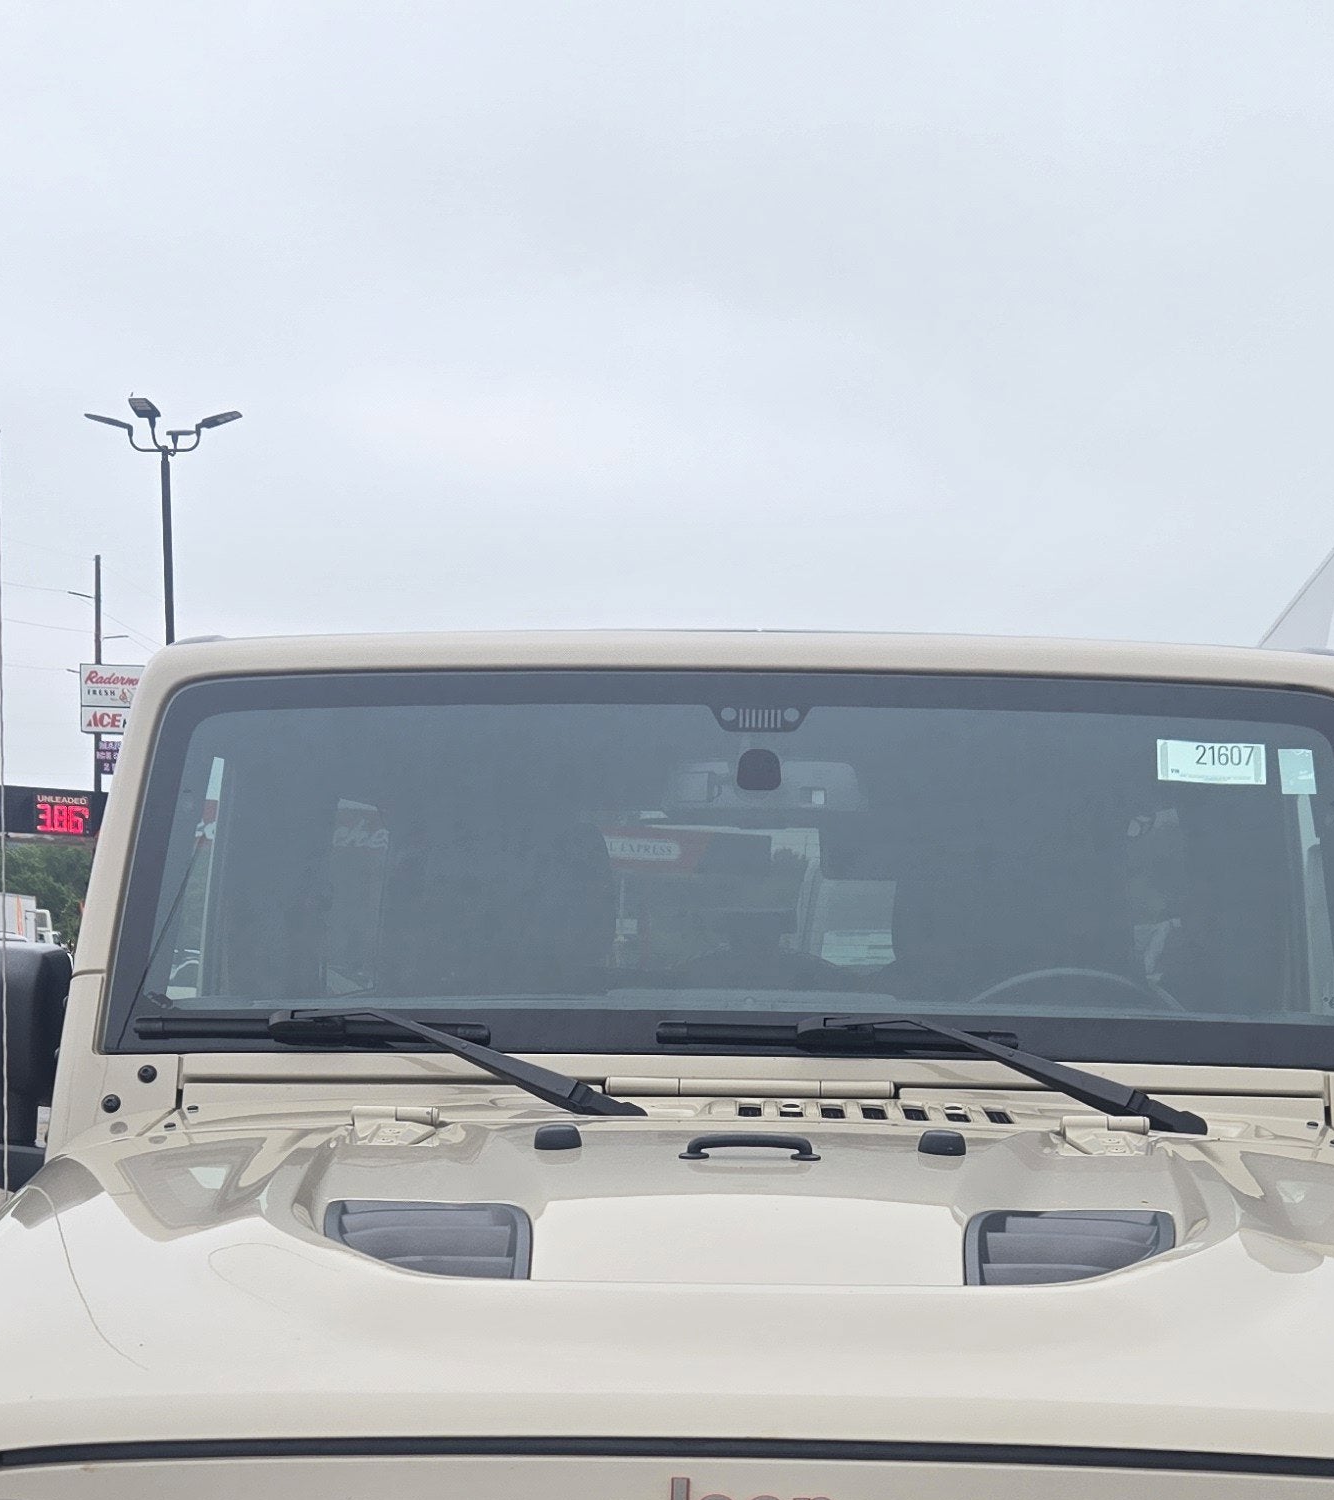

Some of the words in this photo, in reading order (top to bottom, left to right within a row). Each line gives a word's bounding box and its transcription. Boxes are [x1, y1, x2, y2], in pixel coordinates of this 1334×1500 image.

[86, 711, 122, 728] ACE
[1195, 744, 1255, 766] 21607
[36, 795, 88, 805] UNLEADED
